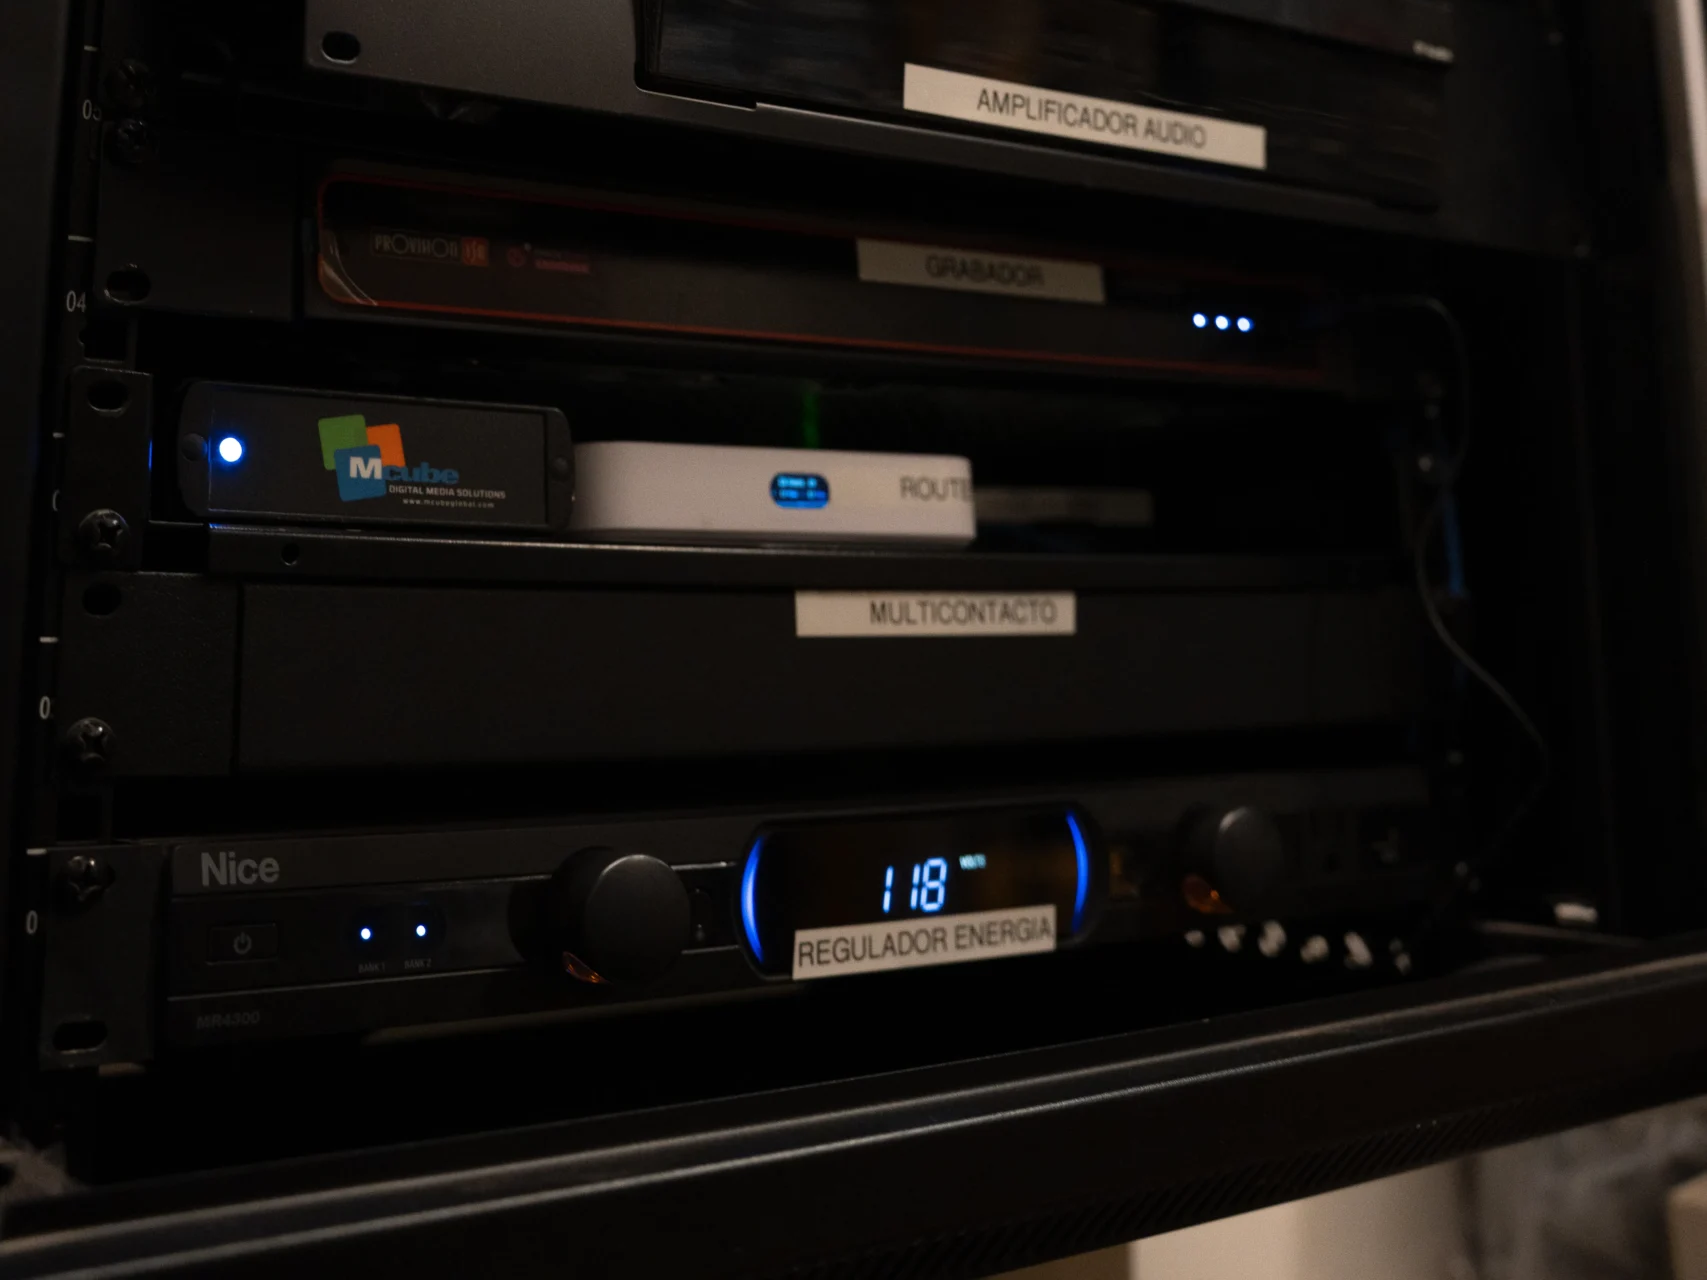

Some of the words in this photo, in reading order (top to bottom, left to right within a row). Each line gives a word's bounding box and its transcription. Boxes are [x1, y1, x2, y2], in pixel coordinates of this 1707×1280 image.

[976, 88, 1138, 136] AMPLIFICADOR
[1142, 117, 1207, 149] AUDIO
[925, 253, 1045, 287] GRABADOR
[66, 289, 88, 313] 04
[388, 484, 424, 496] DIGITAL
[425, 487, 455, 497] MEDIA
[456, 488, 507, 500] SOLUTIONS
[402, 497, 495, 509] www.mcubeglobal.com
[869, 598, 1058, 626] MULTICONTACTO
[200, 850, 280, 887] Nice
[882, 856, 948, 914] 118
[797, 926, 947, 968] REGULADOR
[953, 916, 1053, 951] ENERGIA
[358, 961, 380, 974] BANK
[380, 961, 386, 972] 1
[404, 958, 424, 970] BANK
[426, 957, 432, 968] 2
